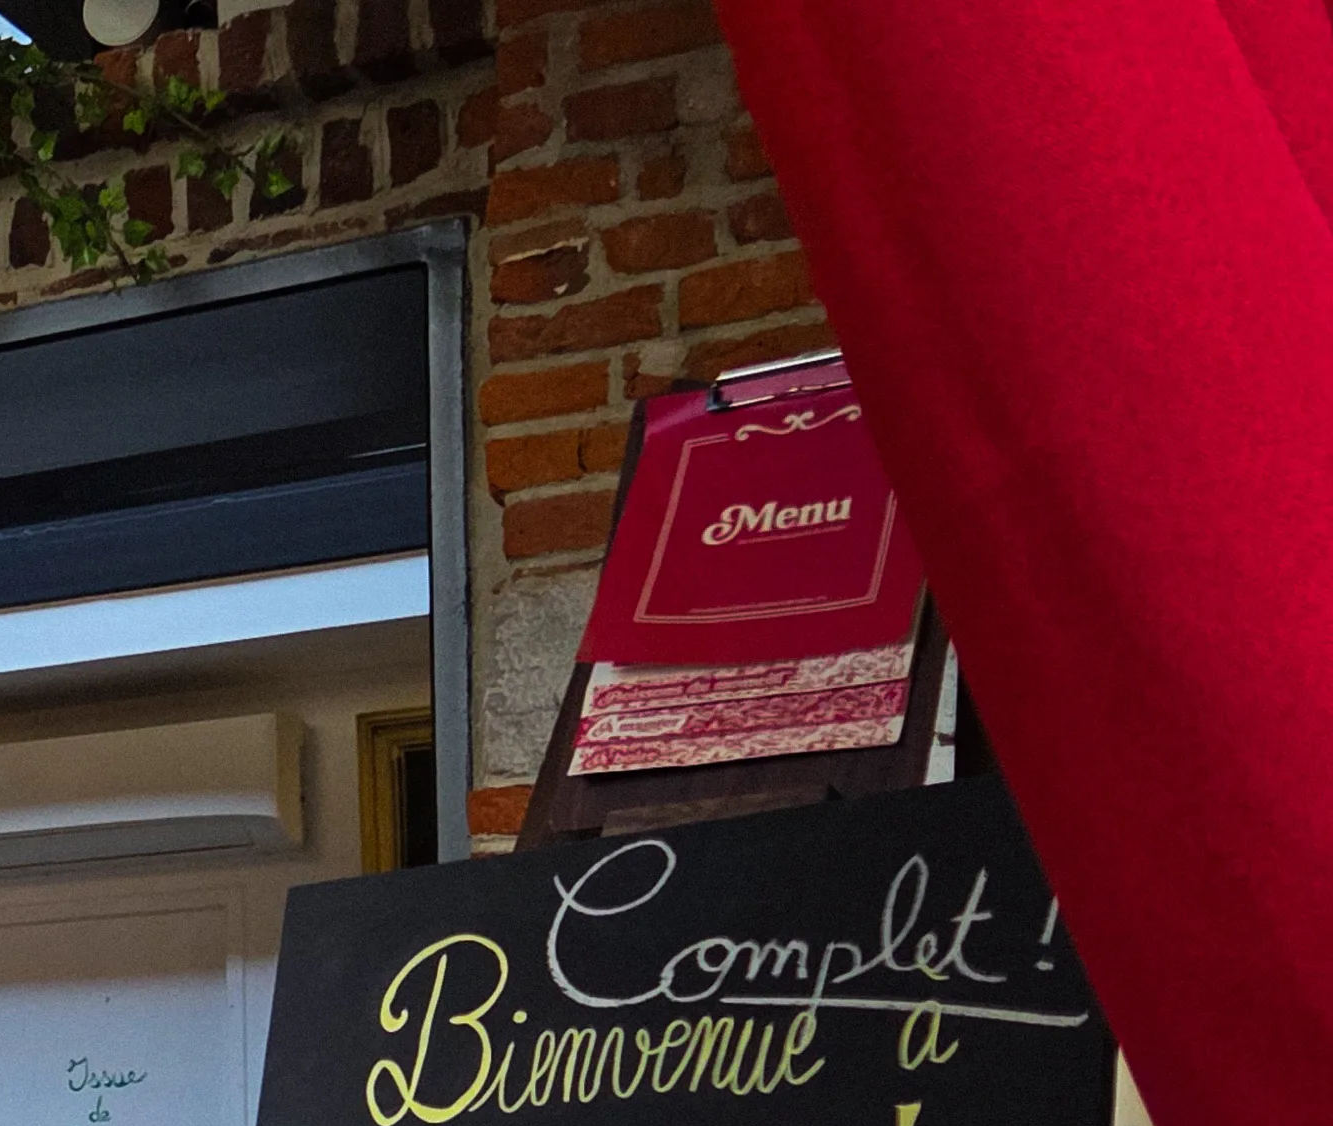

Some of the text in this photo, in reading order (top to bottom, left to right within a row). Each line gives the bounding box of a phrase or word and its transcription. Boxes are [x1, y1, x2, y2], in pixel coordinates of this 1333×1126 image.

[701, 496, 853, 546] Menu
[545, 838, 1009, 1019] Complet
[366, 933, 828, 1126] Bienvenue
[67, 1057, 147, 1092] Issue
[89, 1095, 112, 1123] de
